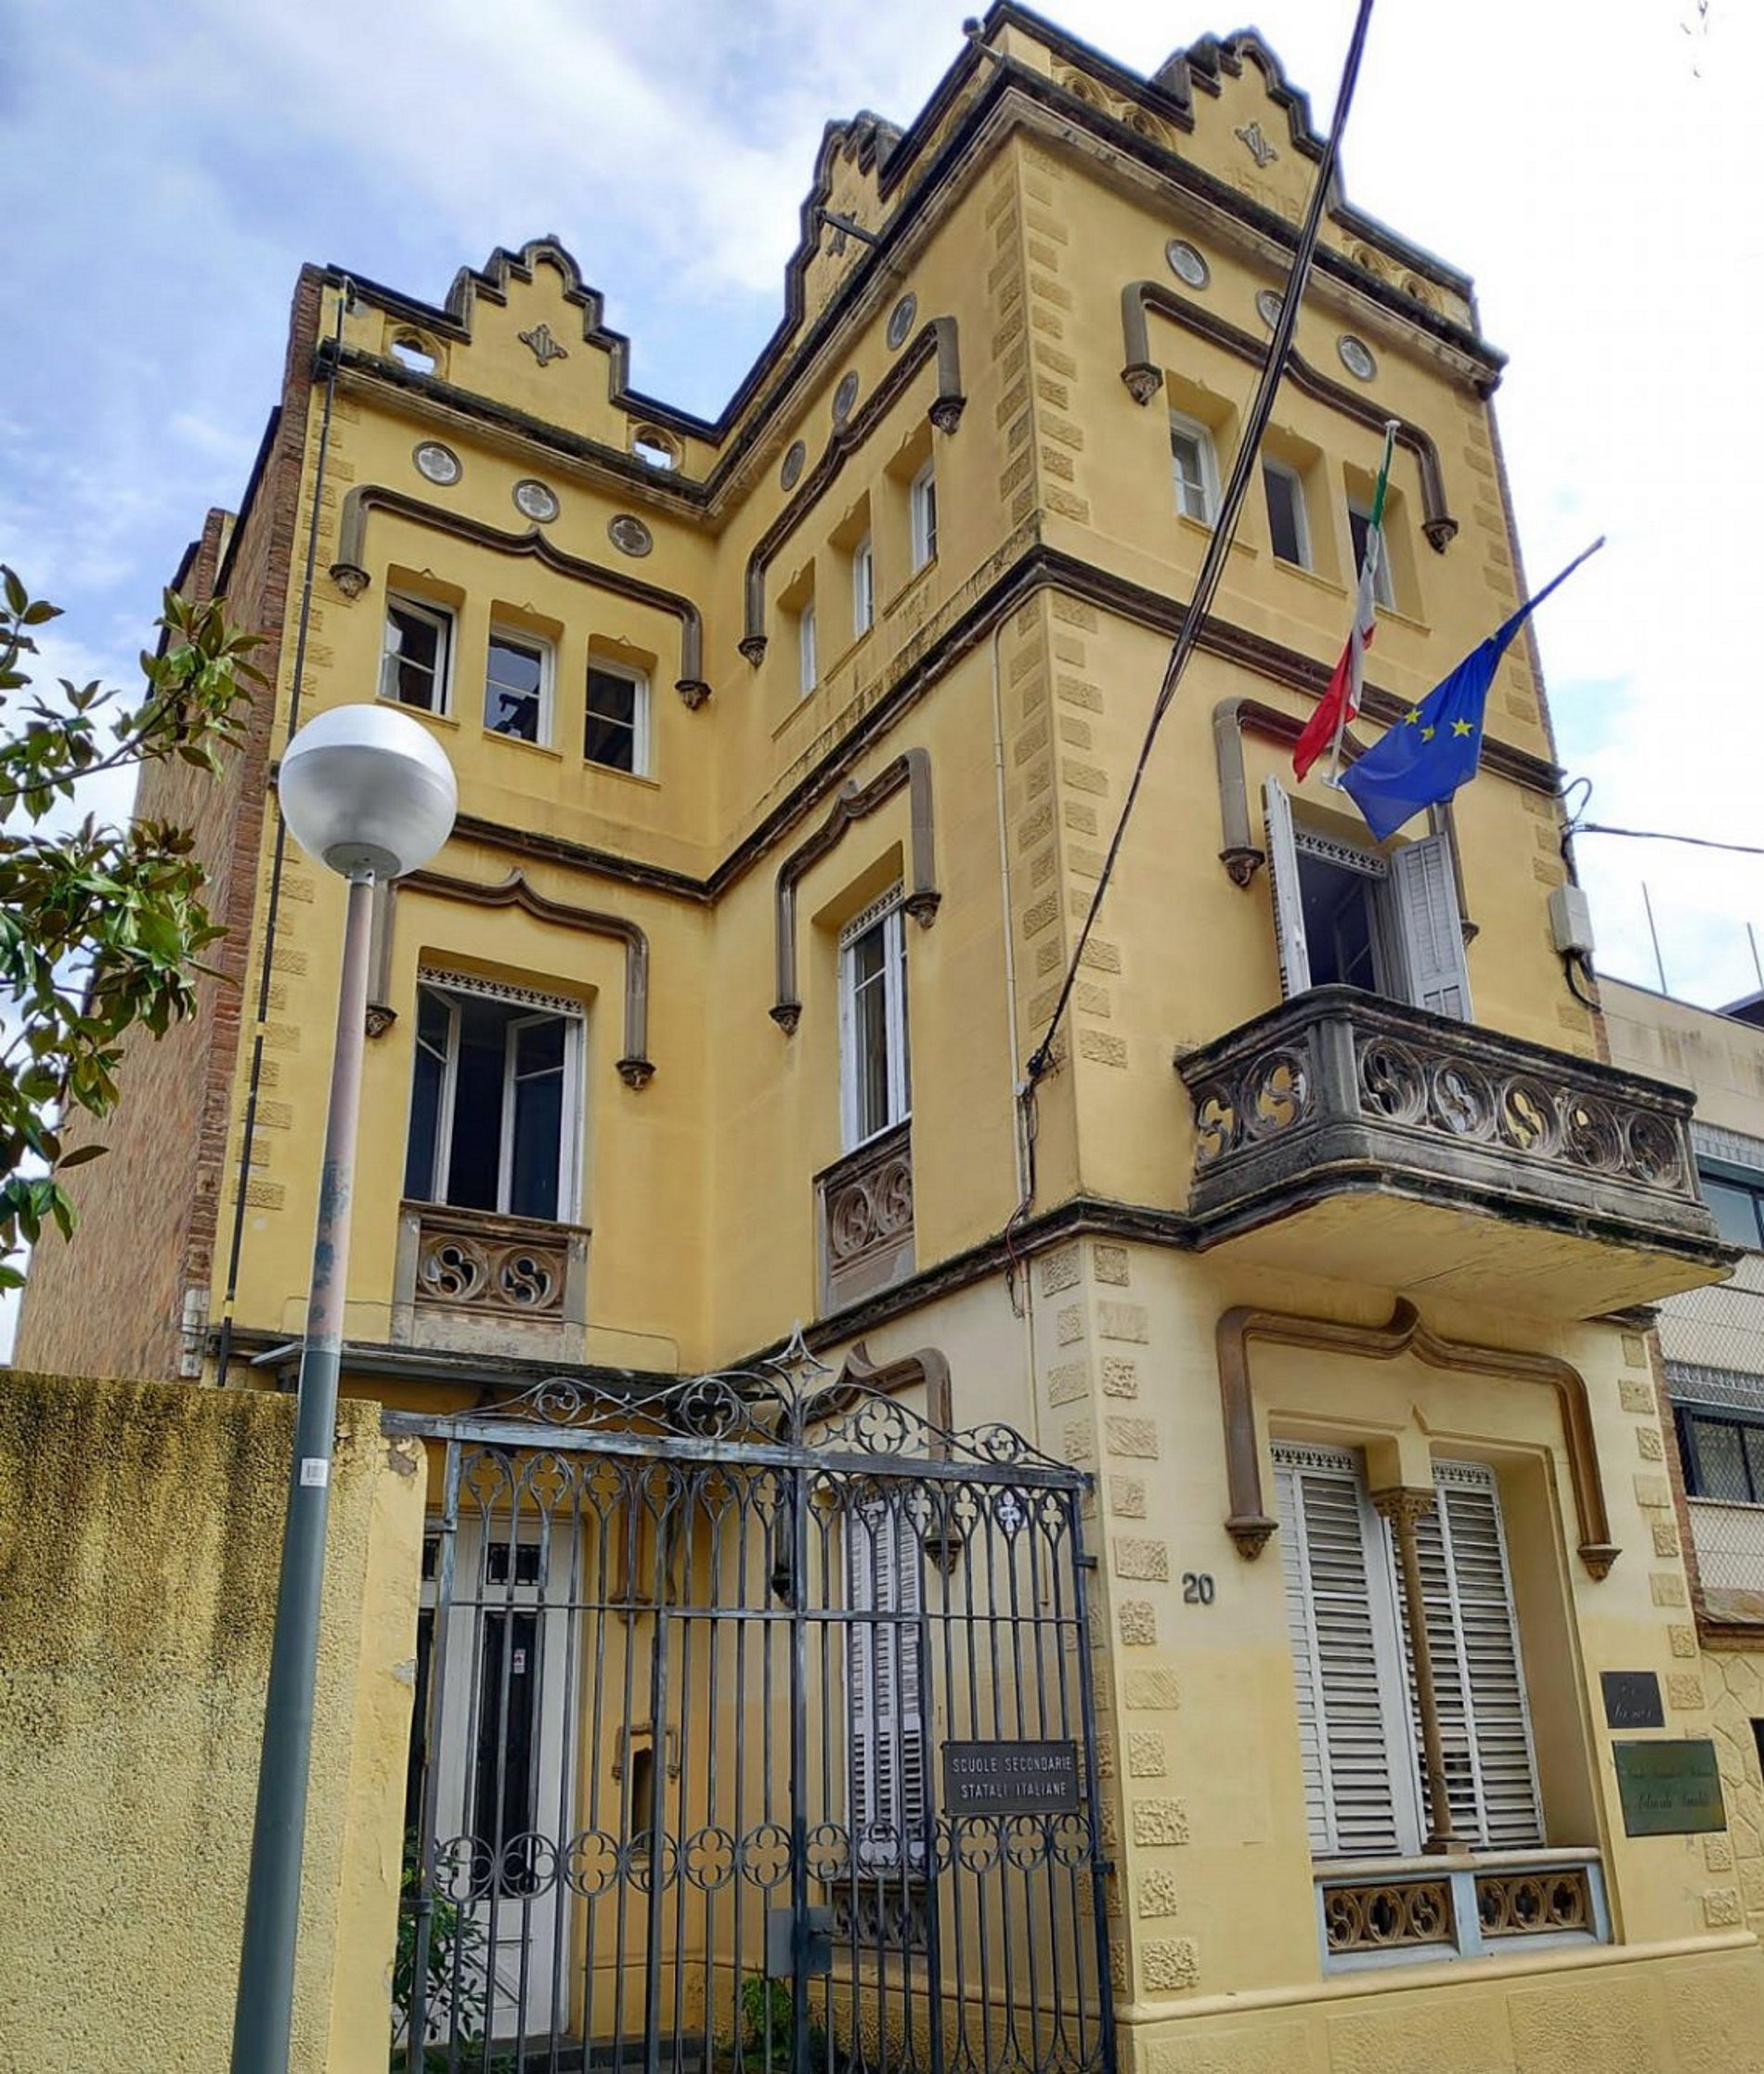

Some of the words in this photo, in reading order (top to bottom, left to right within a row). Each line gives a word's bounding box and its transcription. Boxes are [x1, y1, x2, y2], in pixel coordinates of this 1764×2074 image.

[1182, 1572, 1214, 1604] 20
[953, 1757, 998, 1774] SCUOLE
[1005, 1756, 1072, 1772] SECONDARIE
[961, 1782, 1007, 1798] STATALI
[1016, 1781, 1067, 1796] ITALIANE
